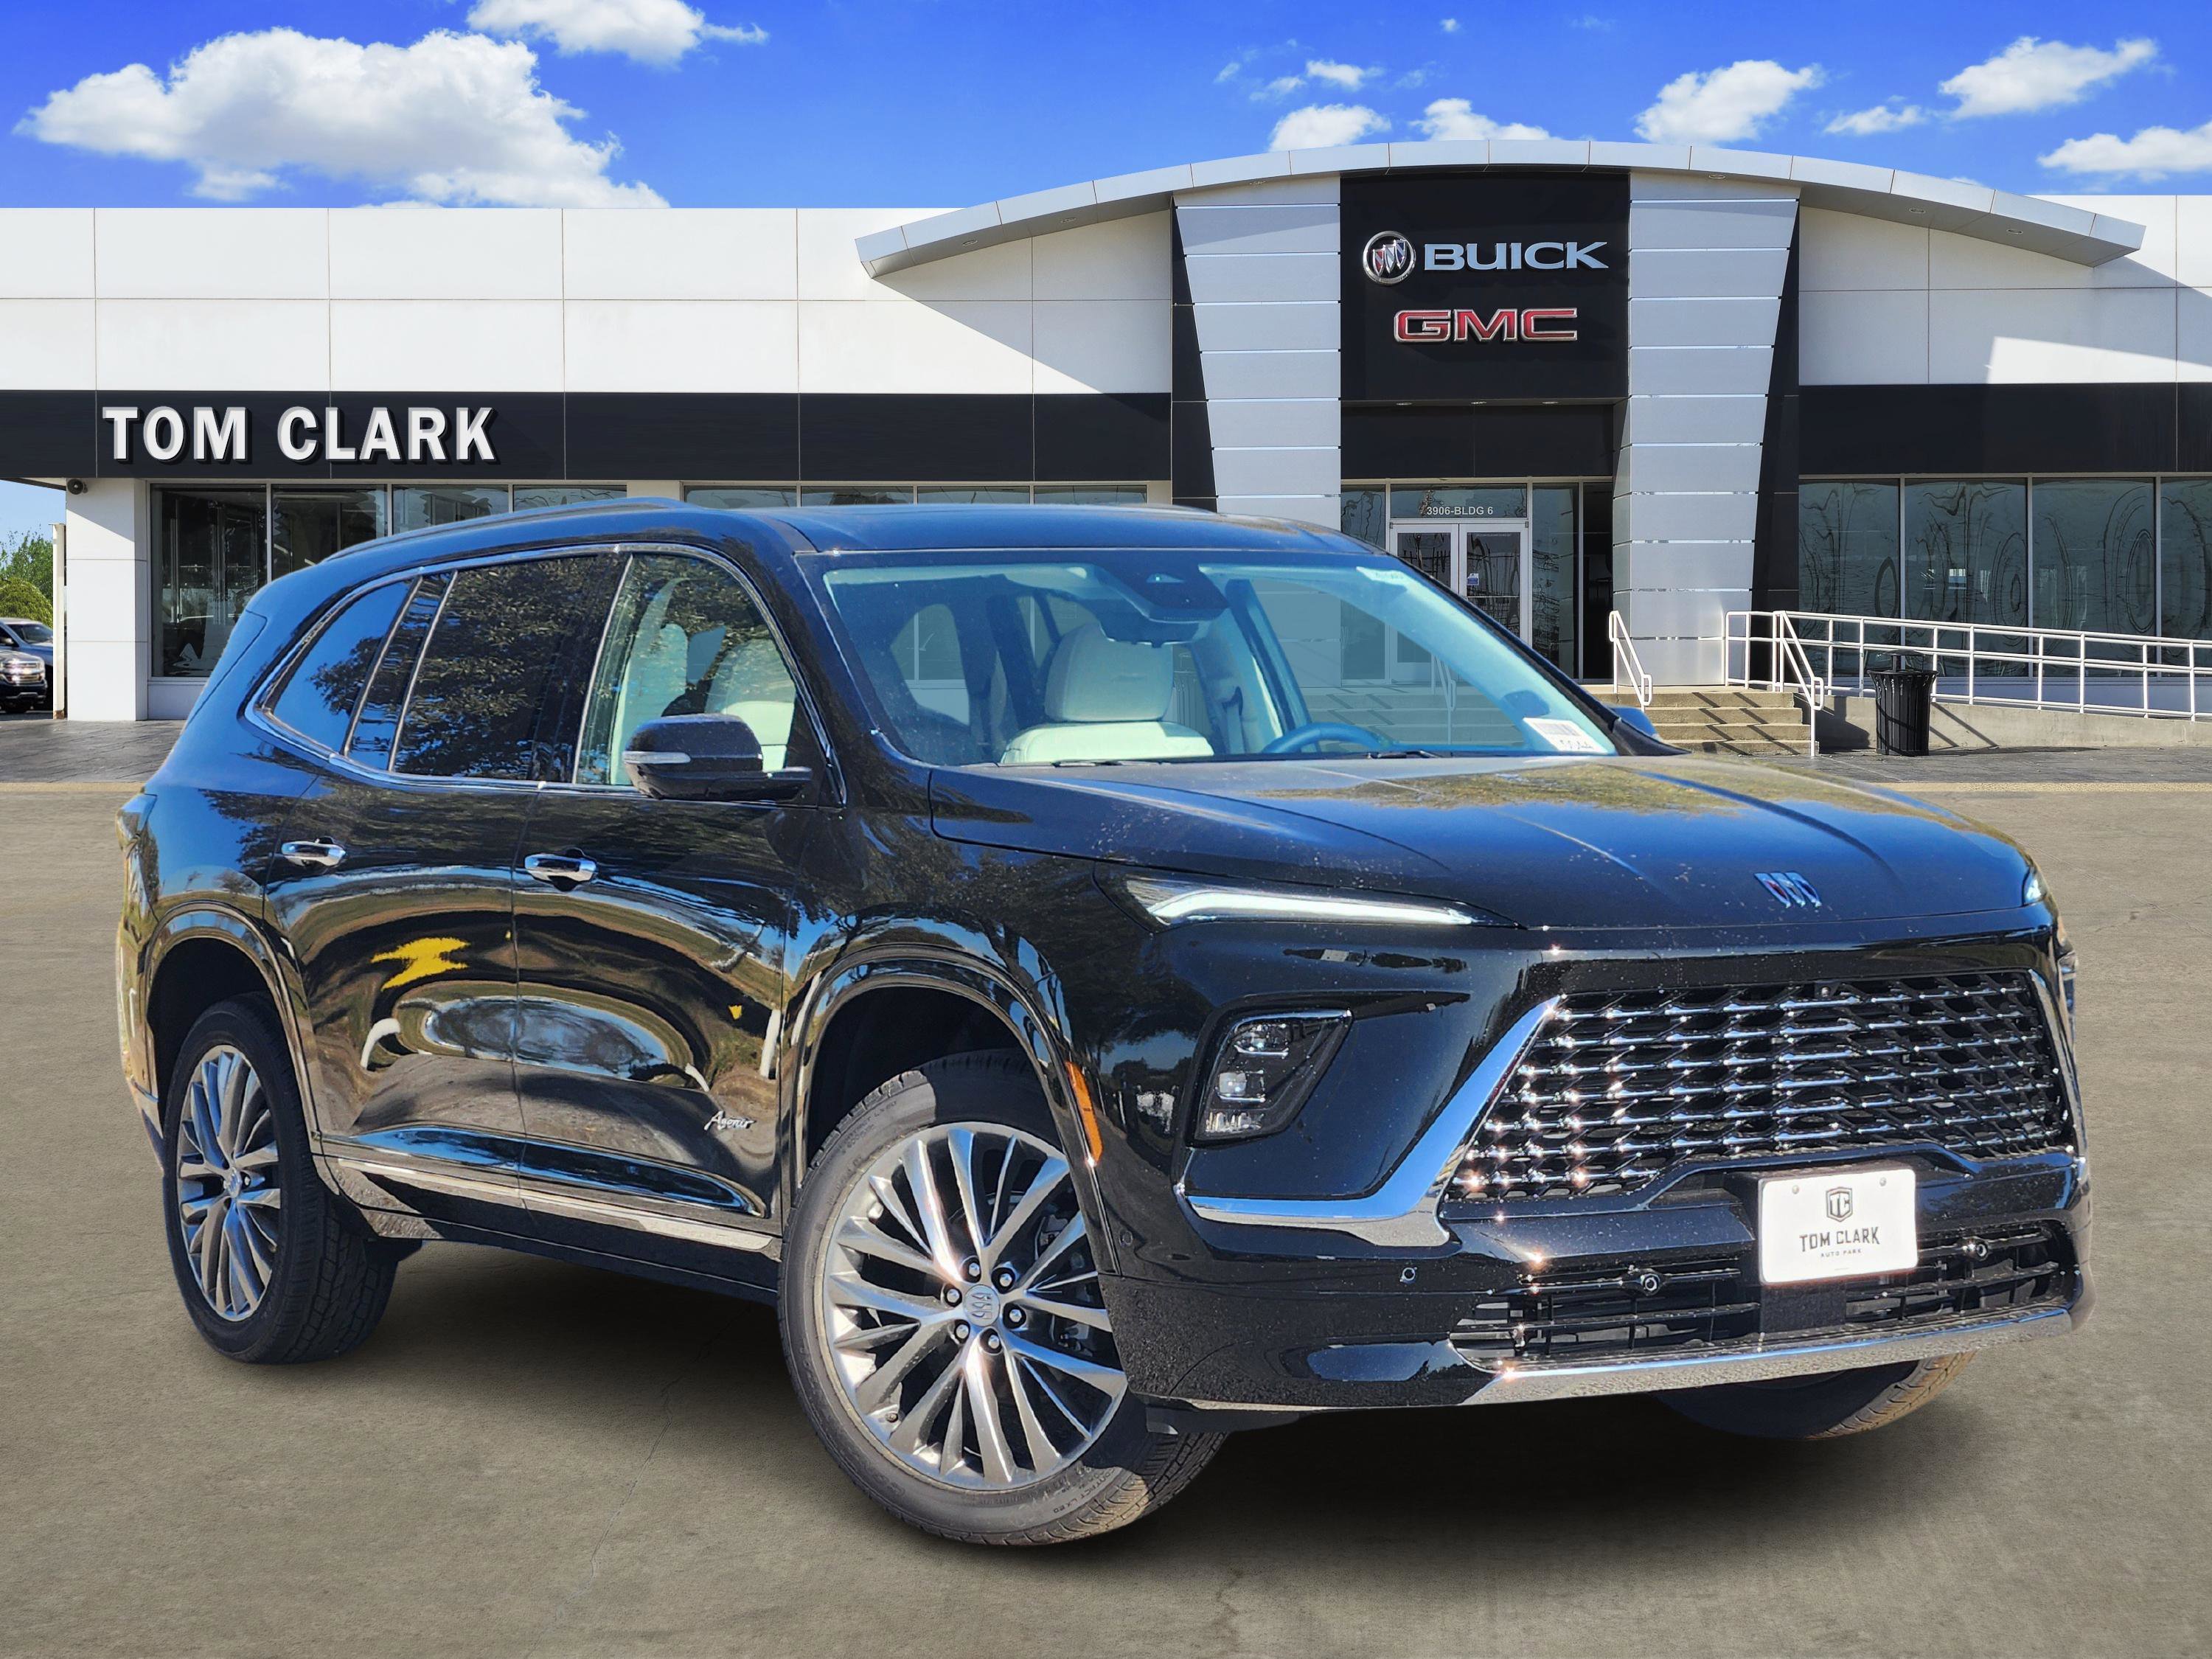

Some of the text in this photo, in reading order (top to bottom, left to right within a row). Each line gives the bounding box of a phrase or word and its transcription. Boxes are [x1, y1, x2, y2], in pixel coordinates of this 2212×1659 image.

[1425, 242, 1609, 271] BUICK
[1394, 307, 1578, 342] GMC
[102, 406, 495, 461] TOM CLARK
[1427, 507, 1494, 515] 3906-BLDG 6
[1799, 1226, 1880, 1253] TOM CLARK
